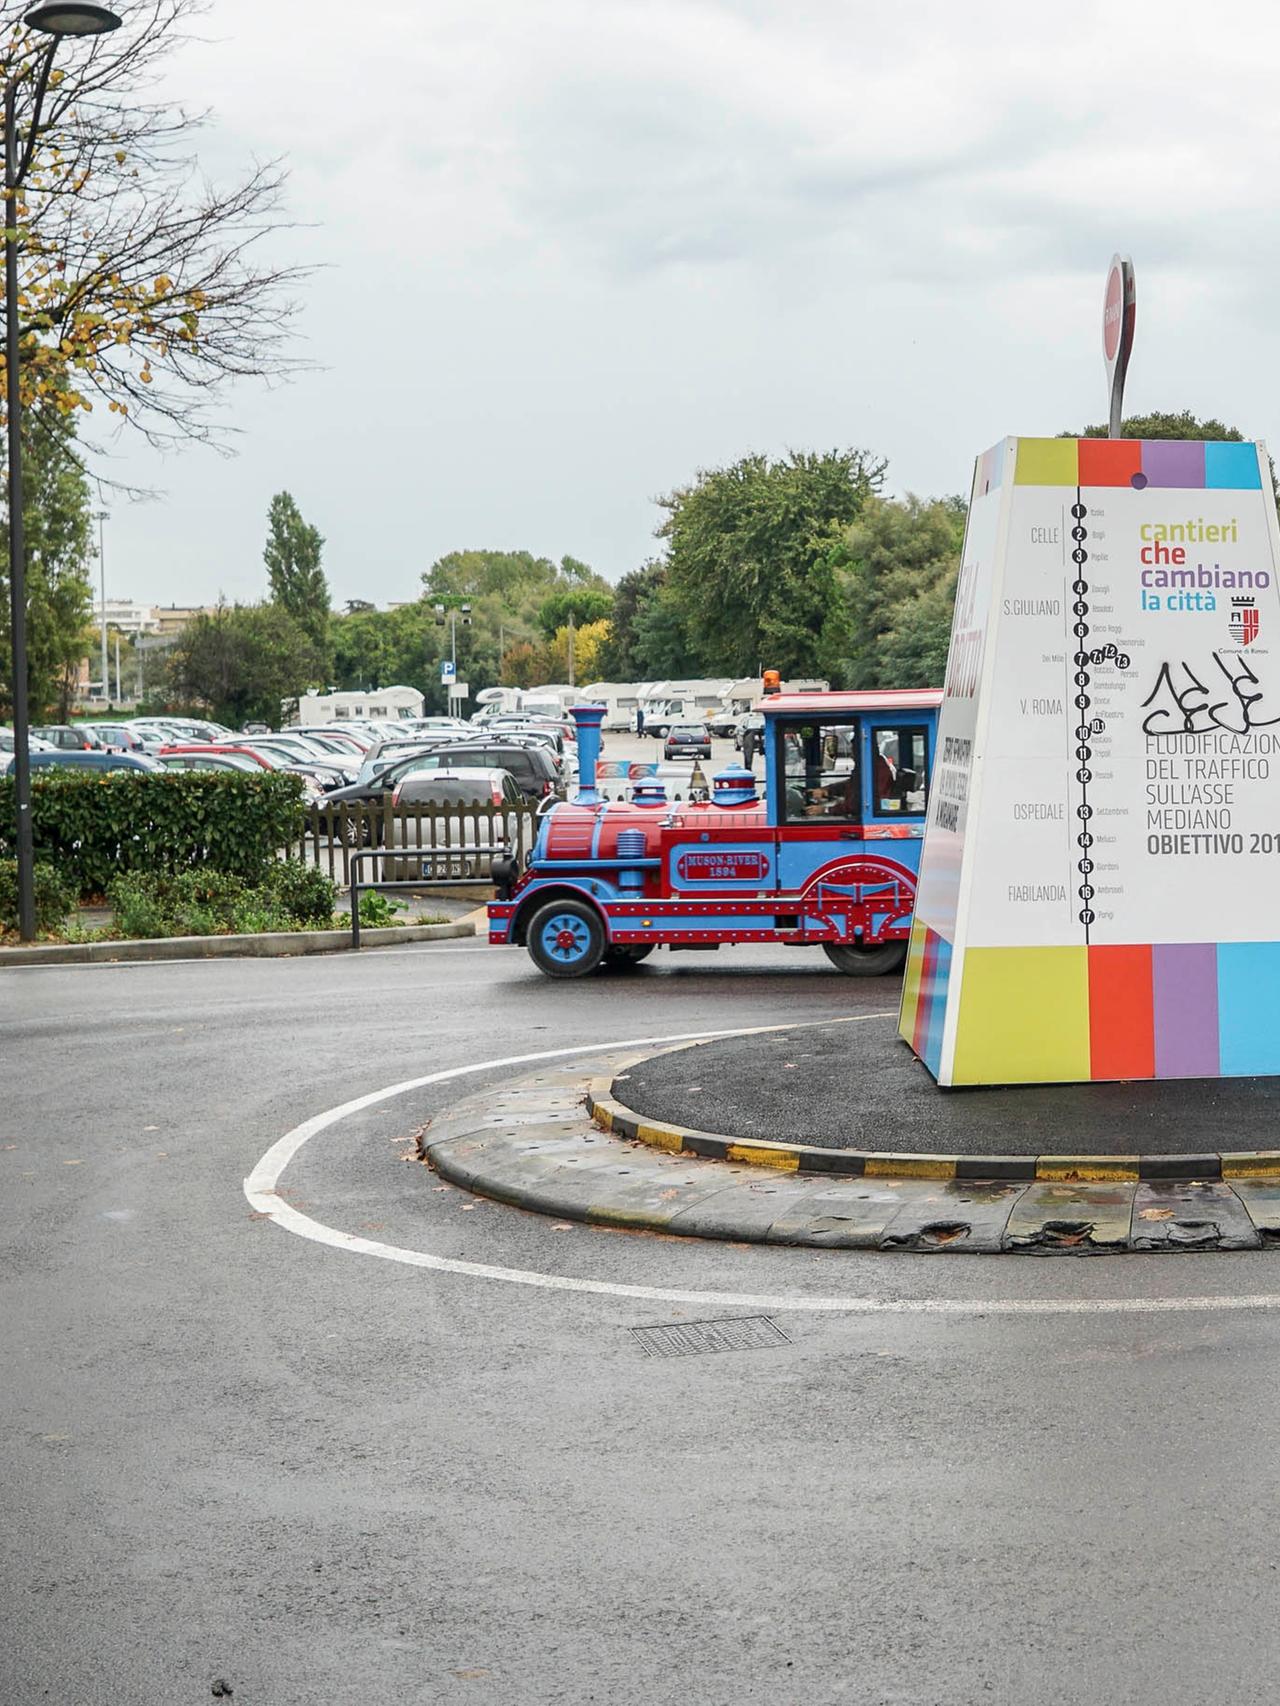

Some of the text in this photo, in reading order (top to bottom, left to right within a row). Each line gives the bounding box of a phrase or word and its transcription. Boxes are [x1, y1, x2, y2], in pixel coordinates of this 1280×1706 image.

[1031, 528, 1059, 544] CELLE
[1076, 528, 1082, 540] 2
[1140, 518, 1237, 543] cantieri
[1076, 550, 1082, 562] 3
[1140, 541, 1186, 565] che
[1141, 564, 1270, 589] cambiano
[1077, 582, 1083, 594] 4
[1141, 590, 1217, 612] la città
[1003, 600, 1060, 617] S.GIULIANO
[1078, 603, 1083, 614] 5
[1078, 625, 1084, 636] 6
[1078, 645, 1128, 667] 7 7.1 7.2 7.3
[444, 663, 453, 674] P
[1079, 674, 1085, 685] 8
[1019, 698, 1063, 715] V. ROMA
[1079, 696, 1085, 708] 9
[1079, 727, 1089, 739] 10
[1079, 748, 1087, 759] 11
[1146, 758, 1269, 780] DEL TRAFFICO
[1079, 770, 1089, 782] 12
[1145, 783, 1234, 806] SULL'ASSE
[1013, 803, 1065, 821] OSPEDALE
[1079, 807, 1089, 818] 13
[1147, 808, 1231, 830] MEDIANO
[1080, 834, 1090, 846] 14
[1147, 833, 1244, 855] OBIETTIVO
[1081, 860, 1091, 872] 15
[1008, 885, 1067, 903] FIABILANDIA
[1081, 886, 1091, 898] 16
[1082, 911, 1092, 923] 17
